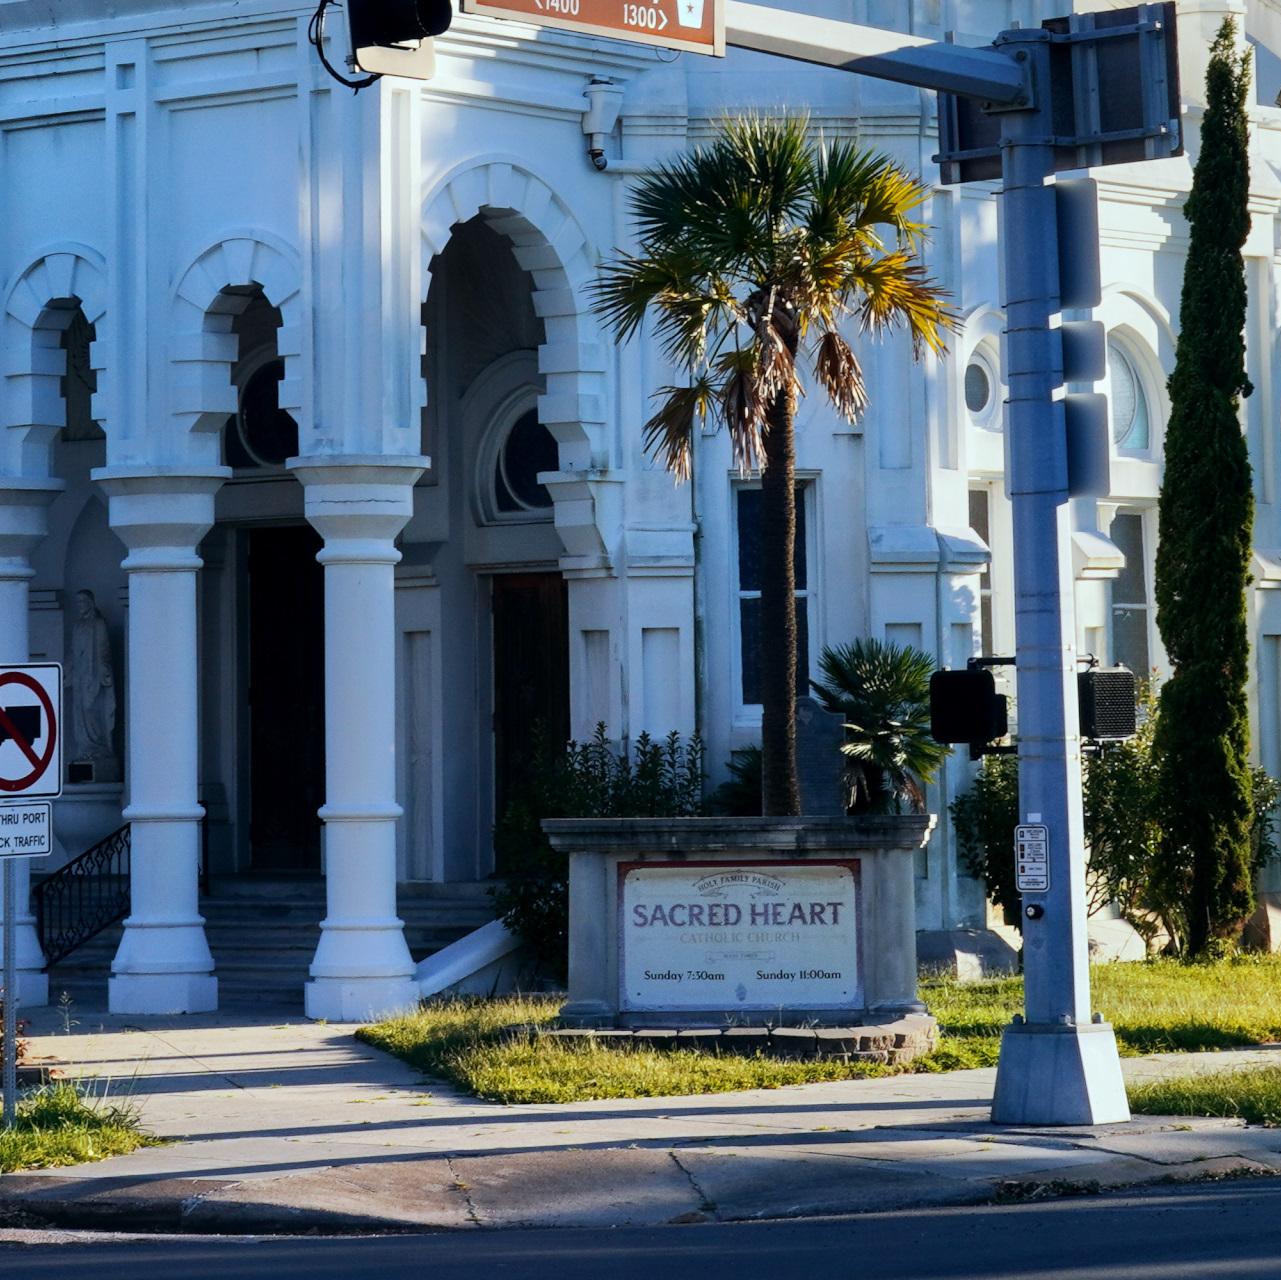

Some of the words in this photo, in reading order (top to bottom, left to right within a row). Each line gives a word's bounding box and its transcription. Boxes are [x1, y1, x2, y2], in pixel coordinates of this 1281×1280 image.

[623, 3, 657, 29] 1300
[22, 812, 46, 824] PORT
[14, 835, 45, 847] TRAFFIC
[698, 879, 718, 892] HOLY
[721, 875, 749, 884] FAMILY
[752, 876, 781, 891] PARISH
[632, 903, 742, 928] SACRED
[749, 902, 845, 927] HEART
[680, 932, 743, 944] CATHOLIC
[747, 931, 800, 943] CHURCH
[644, 970, 684, 982] Sunday
[687, 970, 725, 981] 7:30am
[756, 969, 796, 982] Sunday
[799, 969, 841, 980] 11:00am
